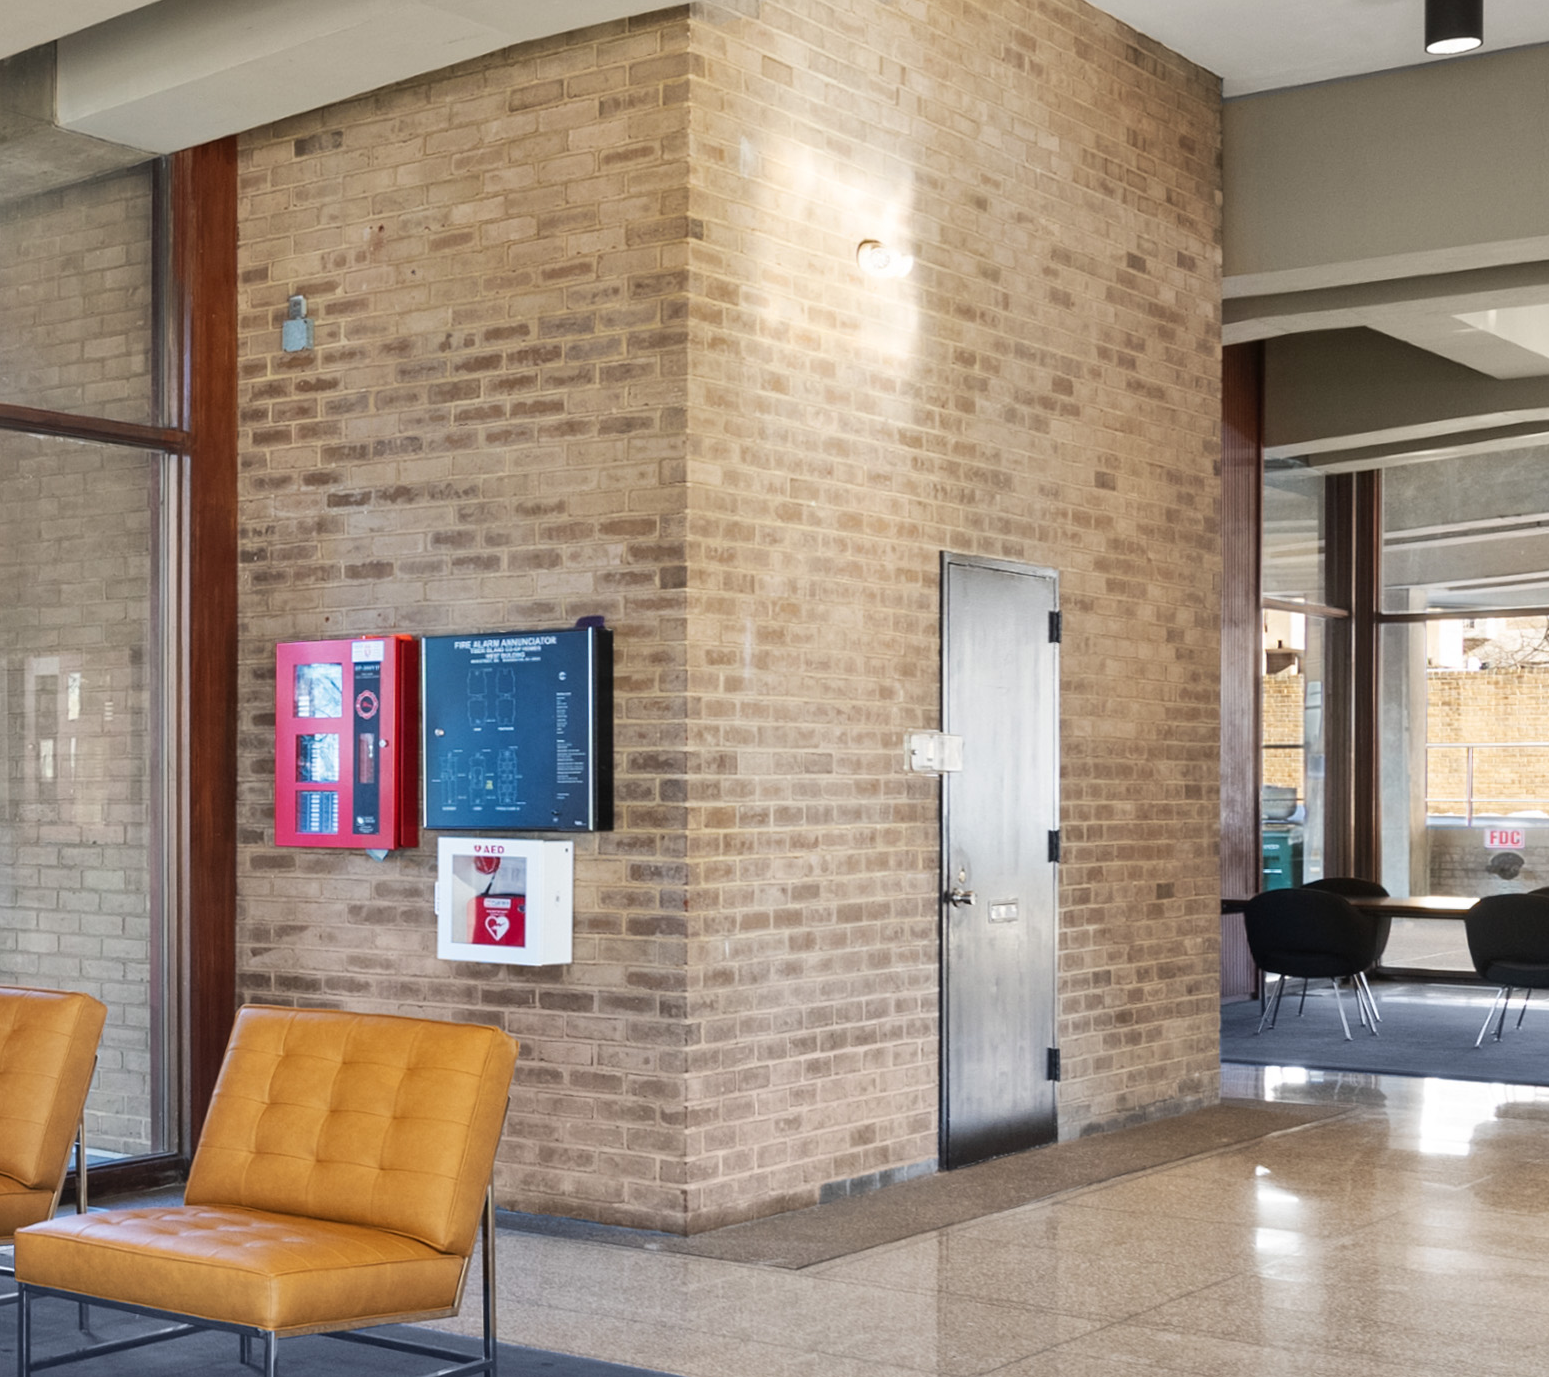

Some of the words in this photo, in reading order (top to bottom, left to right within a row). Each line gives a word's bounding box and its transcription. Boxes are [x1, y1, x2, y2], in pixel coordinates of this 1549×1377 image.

[454, 641, 471, 649] FIRE
[473, 639, 500, 648] ALARM
[501, 636, 557, 647] ANNUNCIATOR
[1490, 830, 1521, 845] FDC
[484, 845, 505, 854] AED
